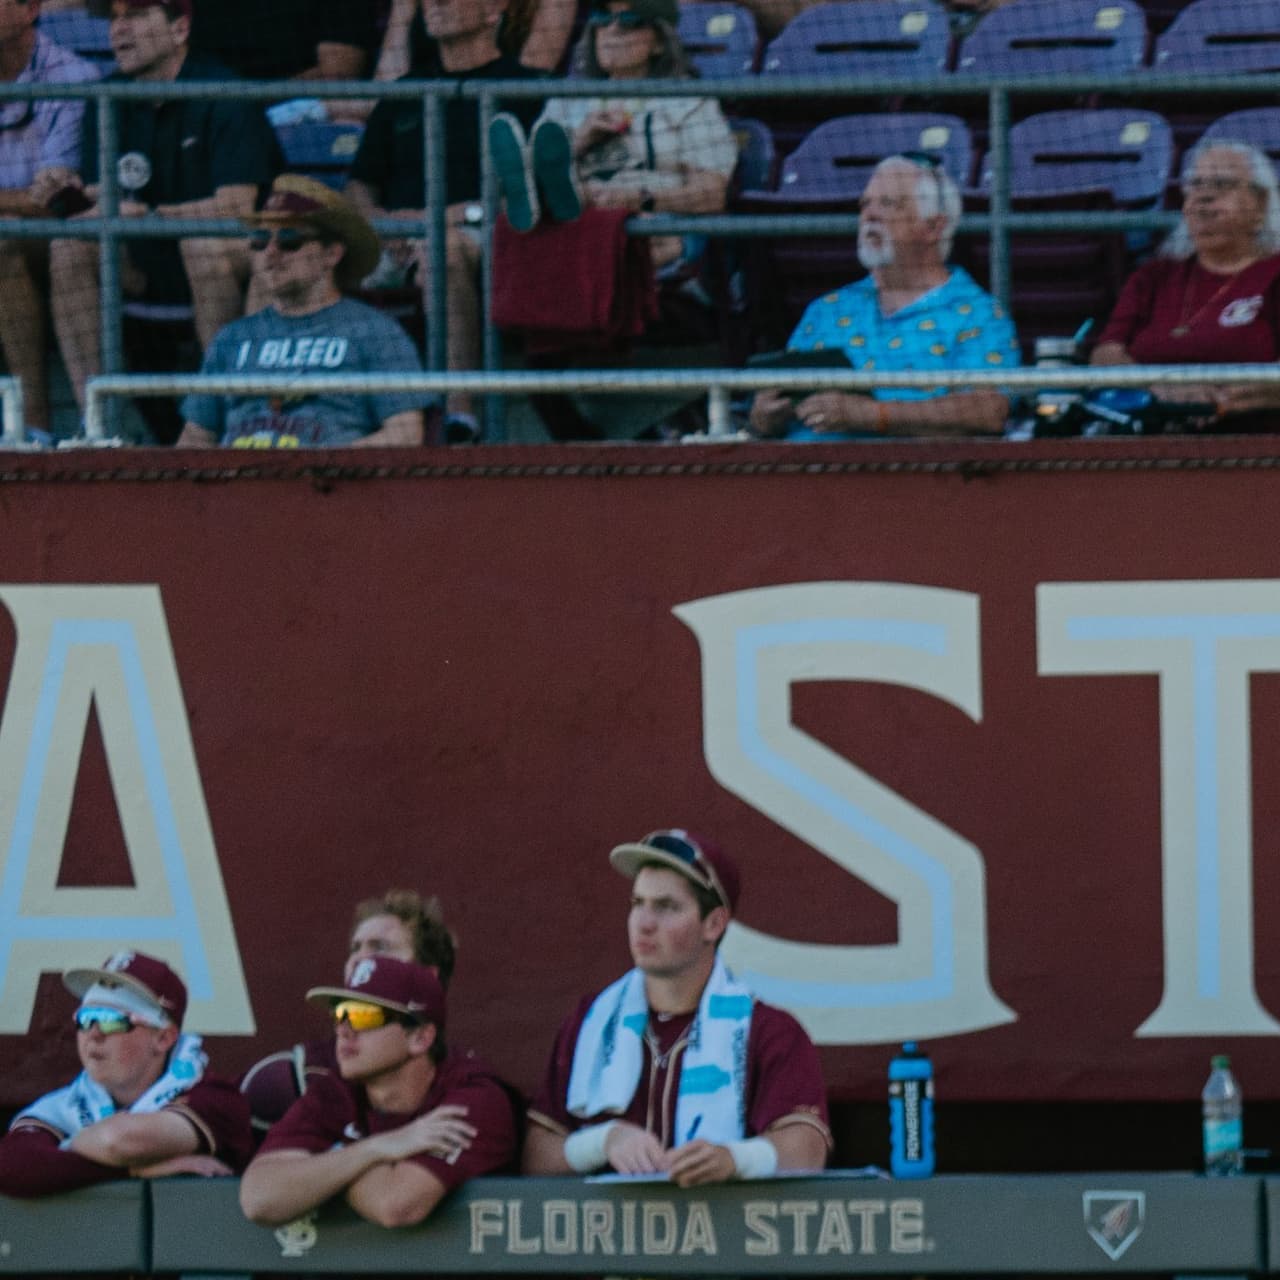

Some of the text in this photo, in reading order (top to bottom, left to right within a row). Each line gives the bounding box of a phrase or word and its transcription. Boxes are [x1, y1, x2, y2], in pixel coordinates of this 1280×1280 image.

[258, 336, 349, 368] BLEED
[468, 1199, 924, 1256] FLORIDA STATE
